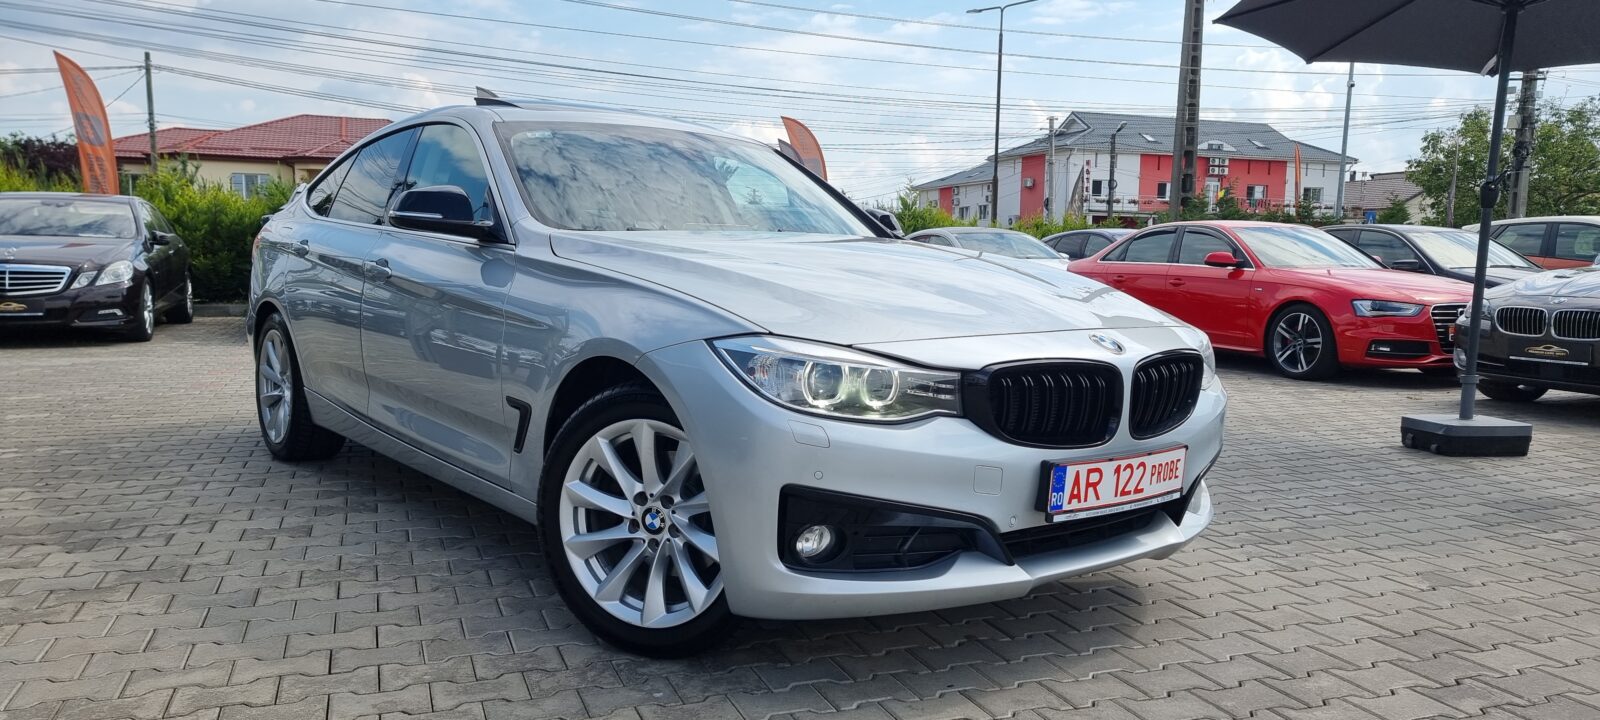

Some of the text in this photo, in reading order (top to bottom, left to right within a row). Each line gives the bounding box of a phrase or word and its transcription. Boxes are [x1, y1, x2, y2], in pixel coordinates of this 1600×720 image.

[1067, 458, 1181, 505] AR 122 PROBE
[1051, 492, 1064, 506] RO
